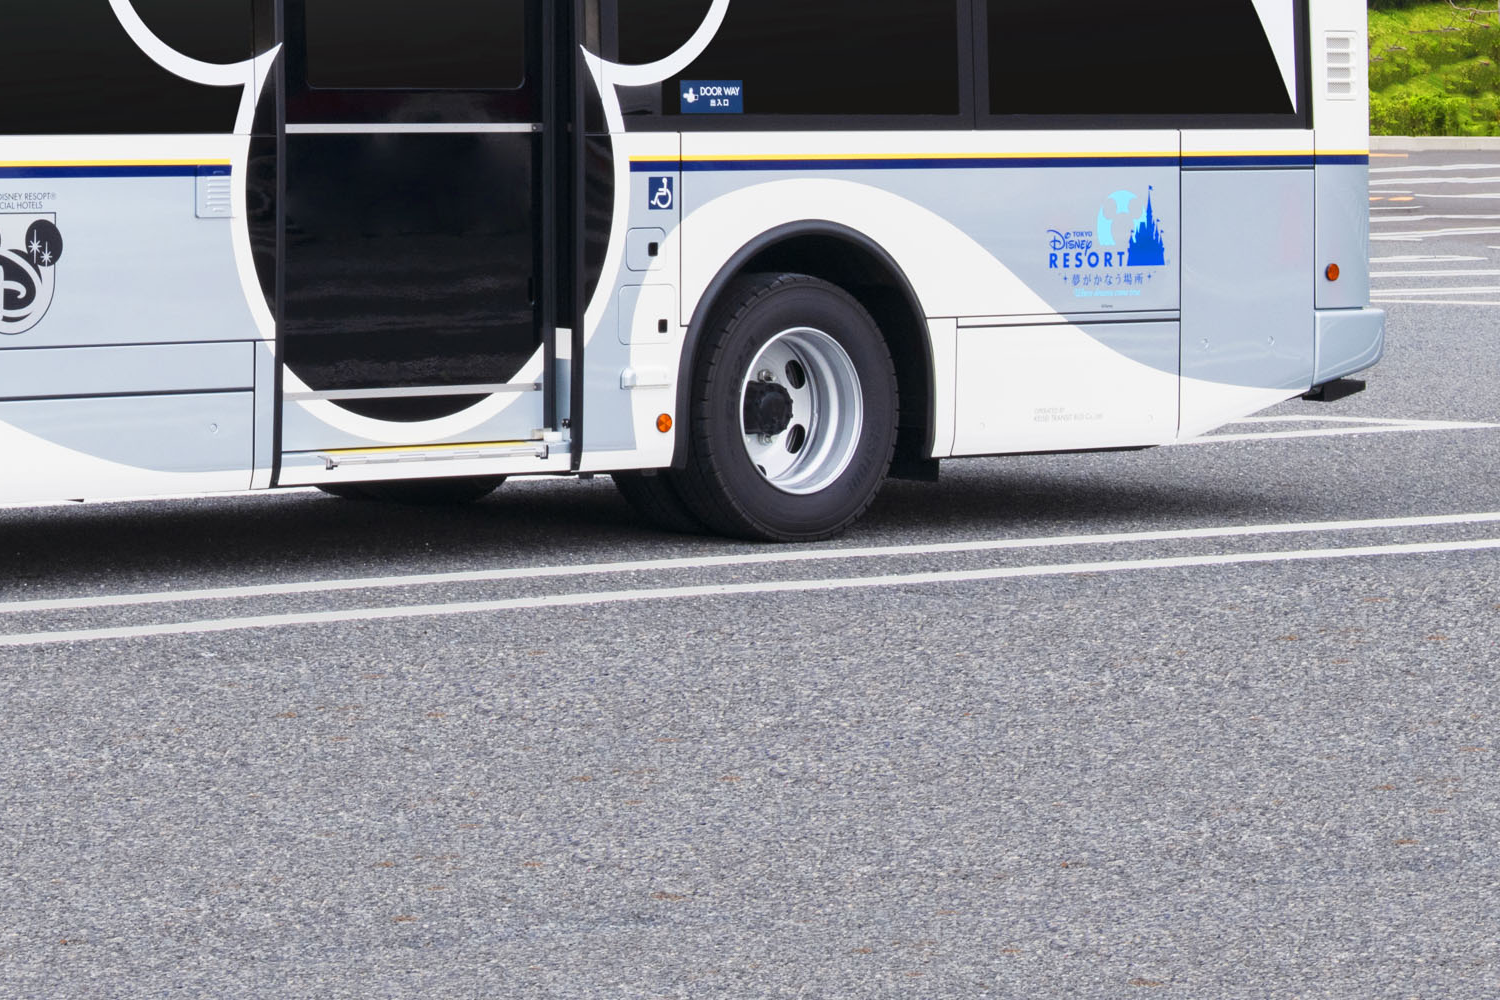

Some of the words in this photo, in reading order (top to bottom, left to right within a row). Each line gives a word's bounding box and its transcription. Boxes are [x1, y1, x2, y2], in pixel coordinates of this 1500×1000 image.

[700, 86, 723, 96] DOOR
[723, 86, 740, 96] WAY
[16, 200, 43, 210] HOTELS
[1049, 251, 1125, 269] RESORT
